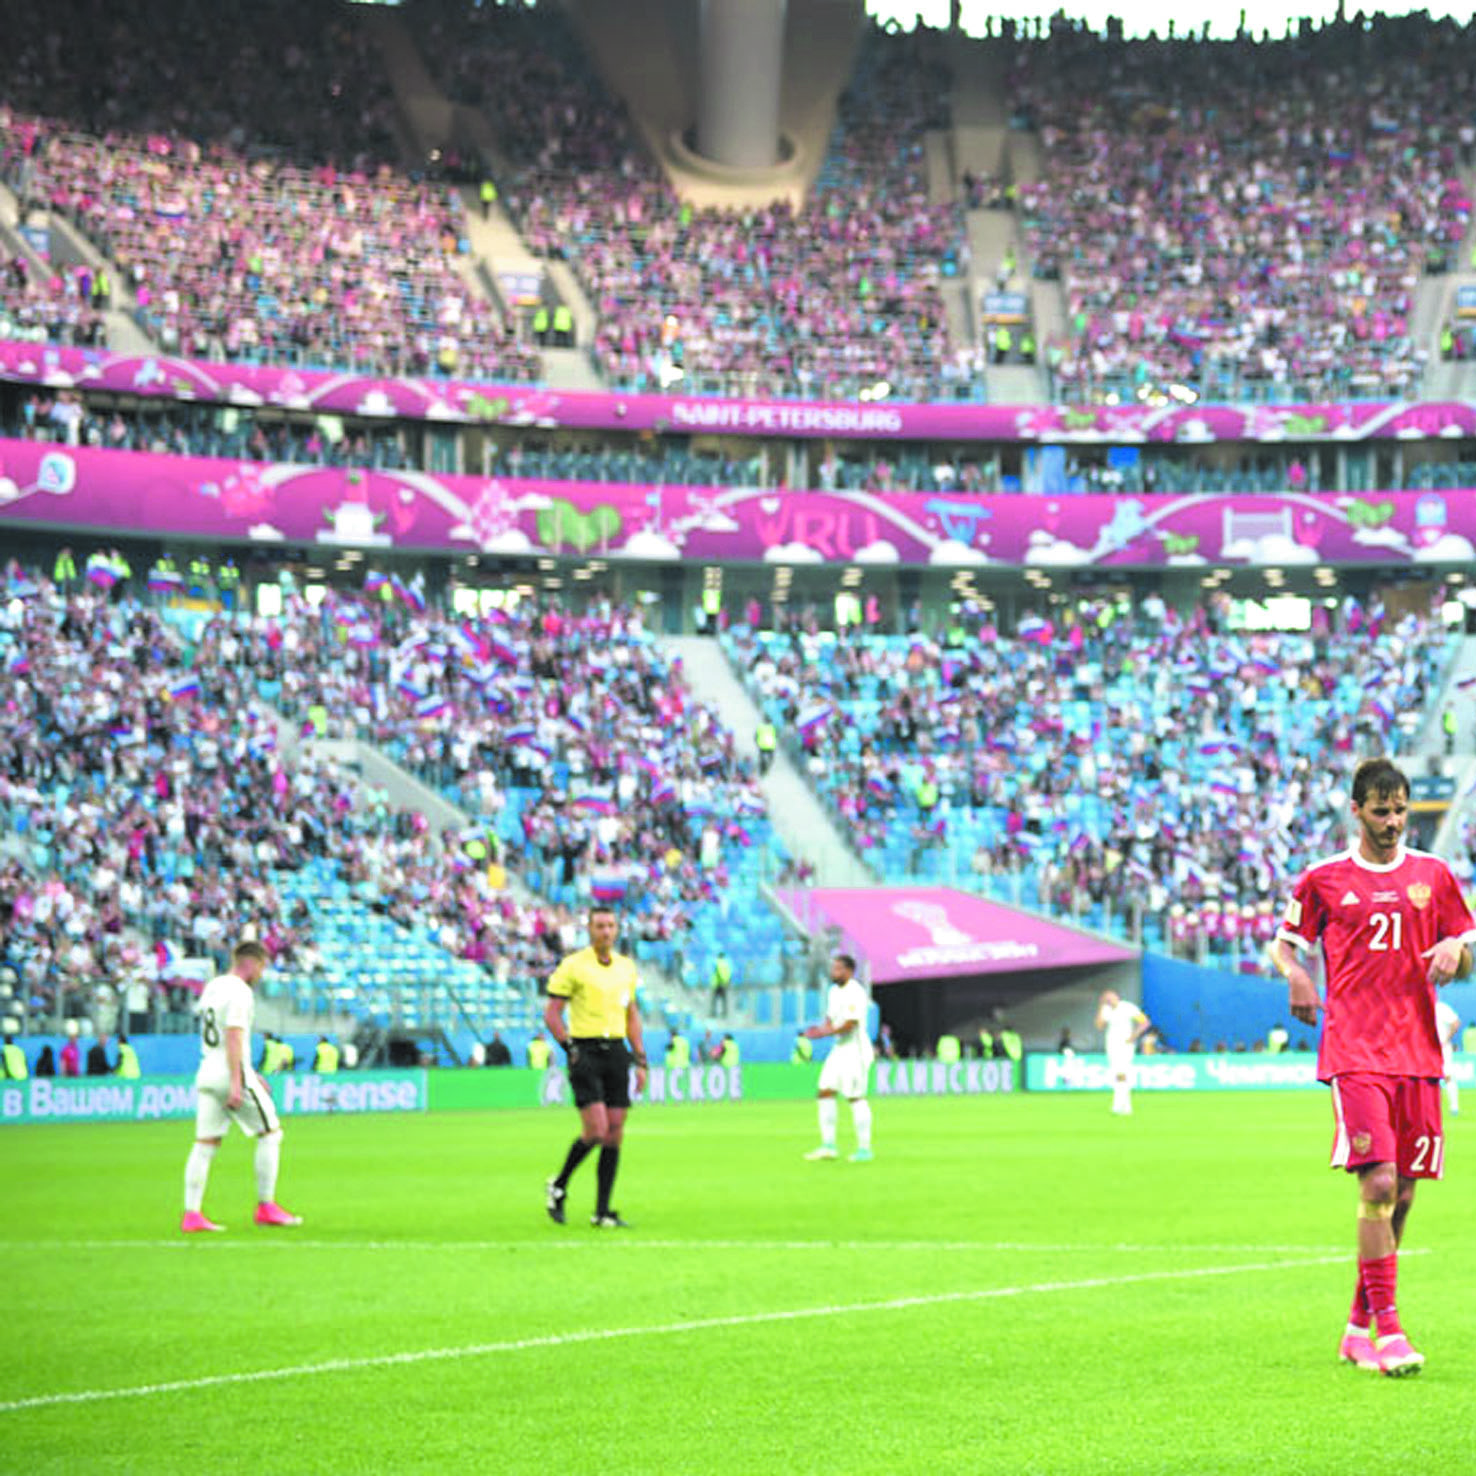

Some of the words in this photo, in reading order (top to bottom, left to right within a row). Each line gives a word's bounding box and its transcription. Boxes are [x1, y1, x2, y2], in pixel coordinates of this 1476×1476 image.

[1369, 912, 1402, 950] 21
[1044, 1055, 1196, 1088] Hisnse
[137, 1084, 200, 1120] дом
[284, 1073, 418, 1112] Hisense
[1411, 1135, 1441, 1172] 21
